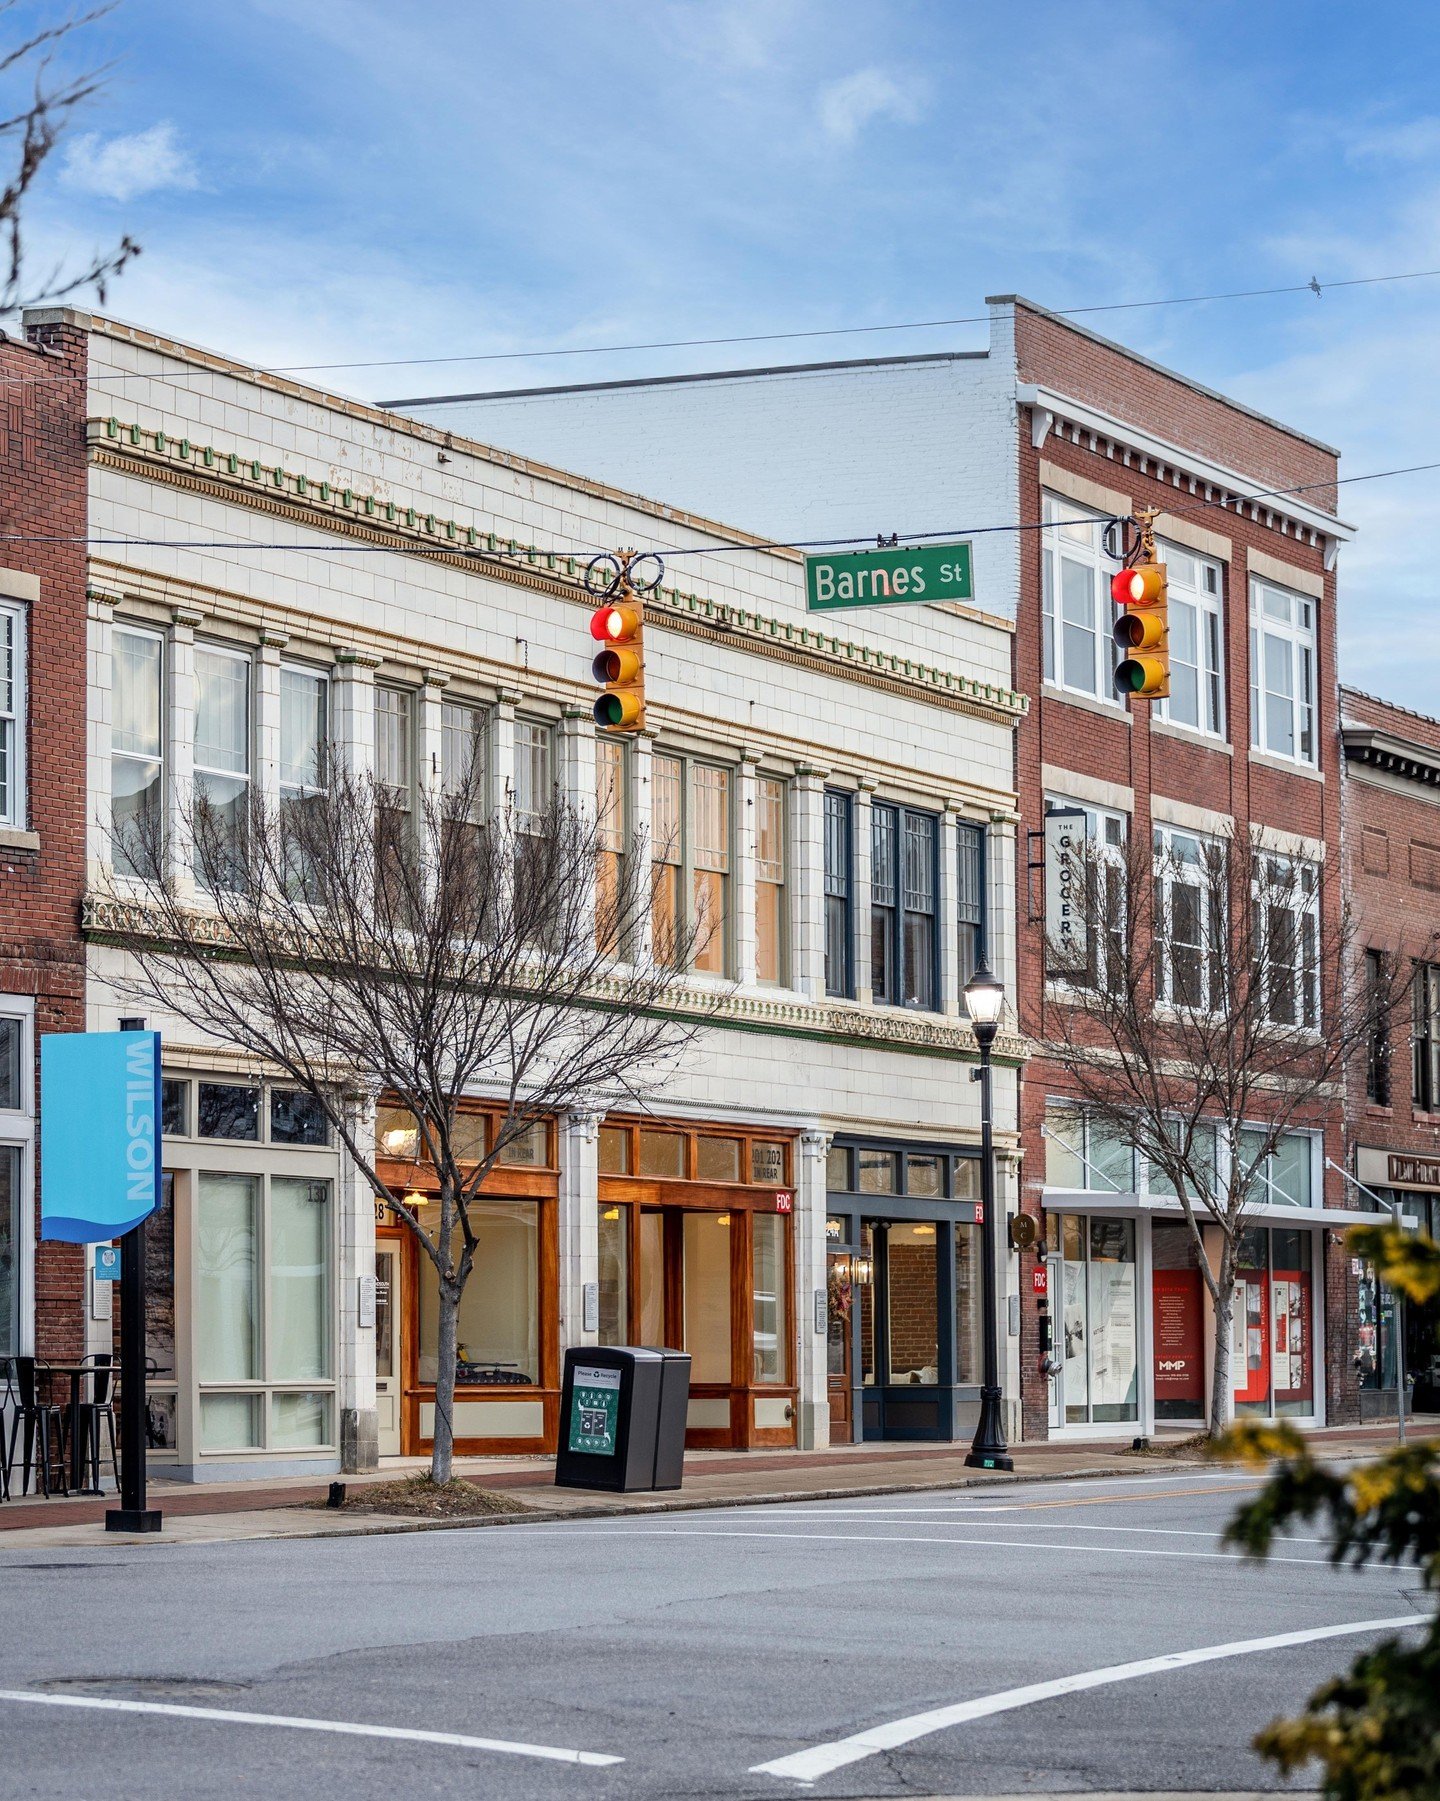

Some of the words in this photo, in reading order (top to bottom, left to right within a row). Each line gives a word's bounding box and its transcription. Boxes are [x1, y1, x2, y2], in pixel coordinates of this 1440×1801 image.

[815, 565, 926, 601] Barnes
[939, 563, 963, 583] St
[1060, 835, 1072, 951] GROCERY
[126, 1038, 154, 1200] WILSON
[767, 1149, 781, 1166] 202
[754, 1166, 762, 1179] IN
[762, 1167, 778, 1180] REAR
[776, 1193, 791, 1210] FDC
[975, 1205, 983, 1219] FD
[1034, 1272, 1046, 1288] FDC
[1158, 1360, 1186, 1371] MMP
